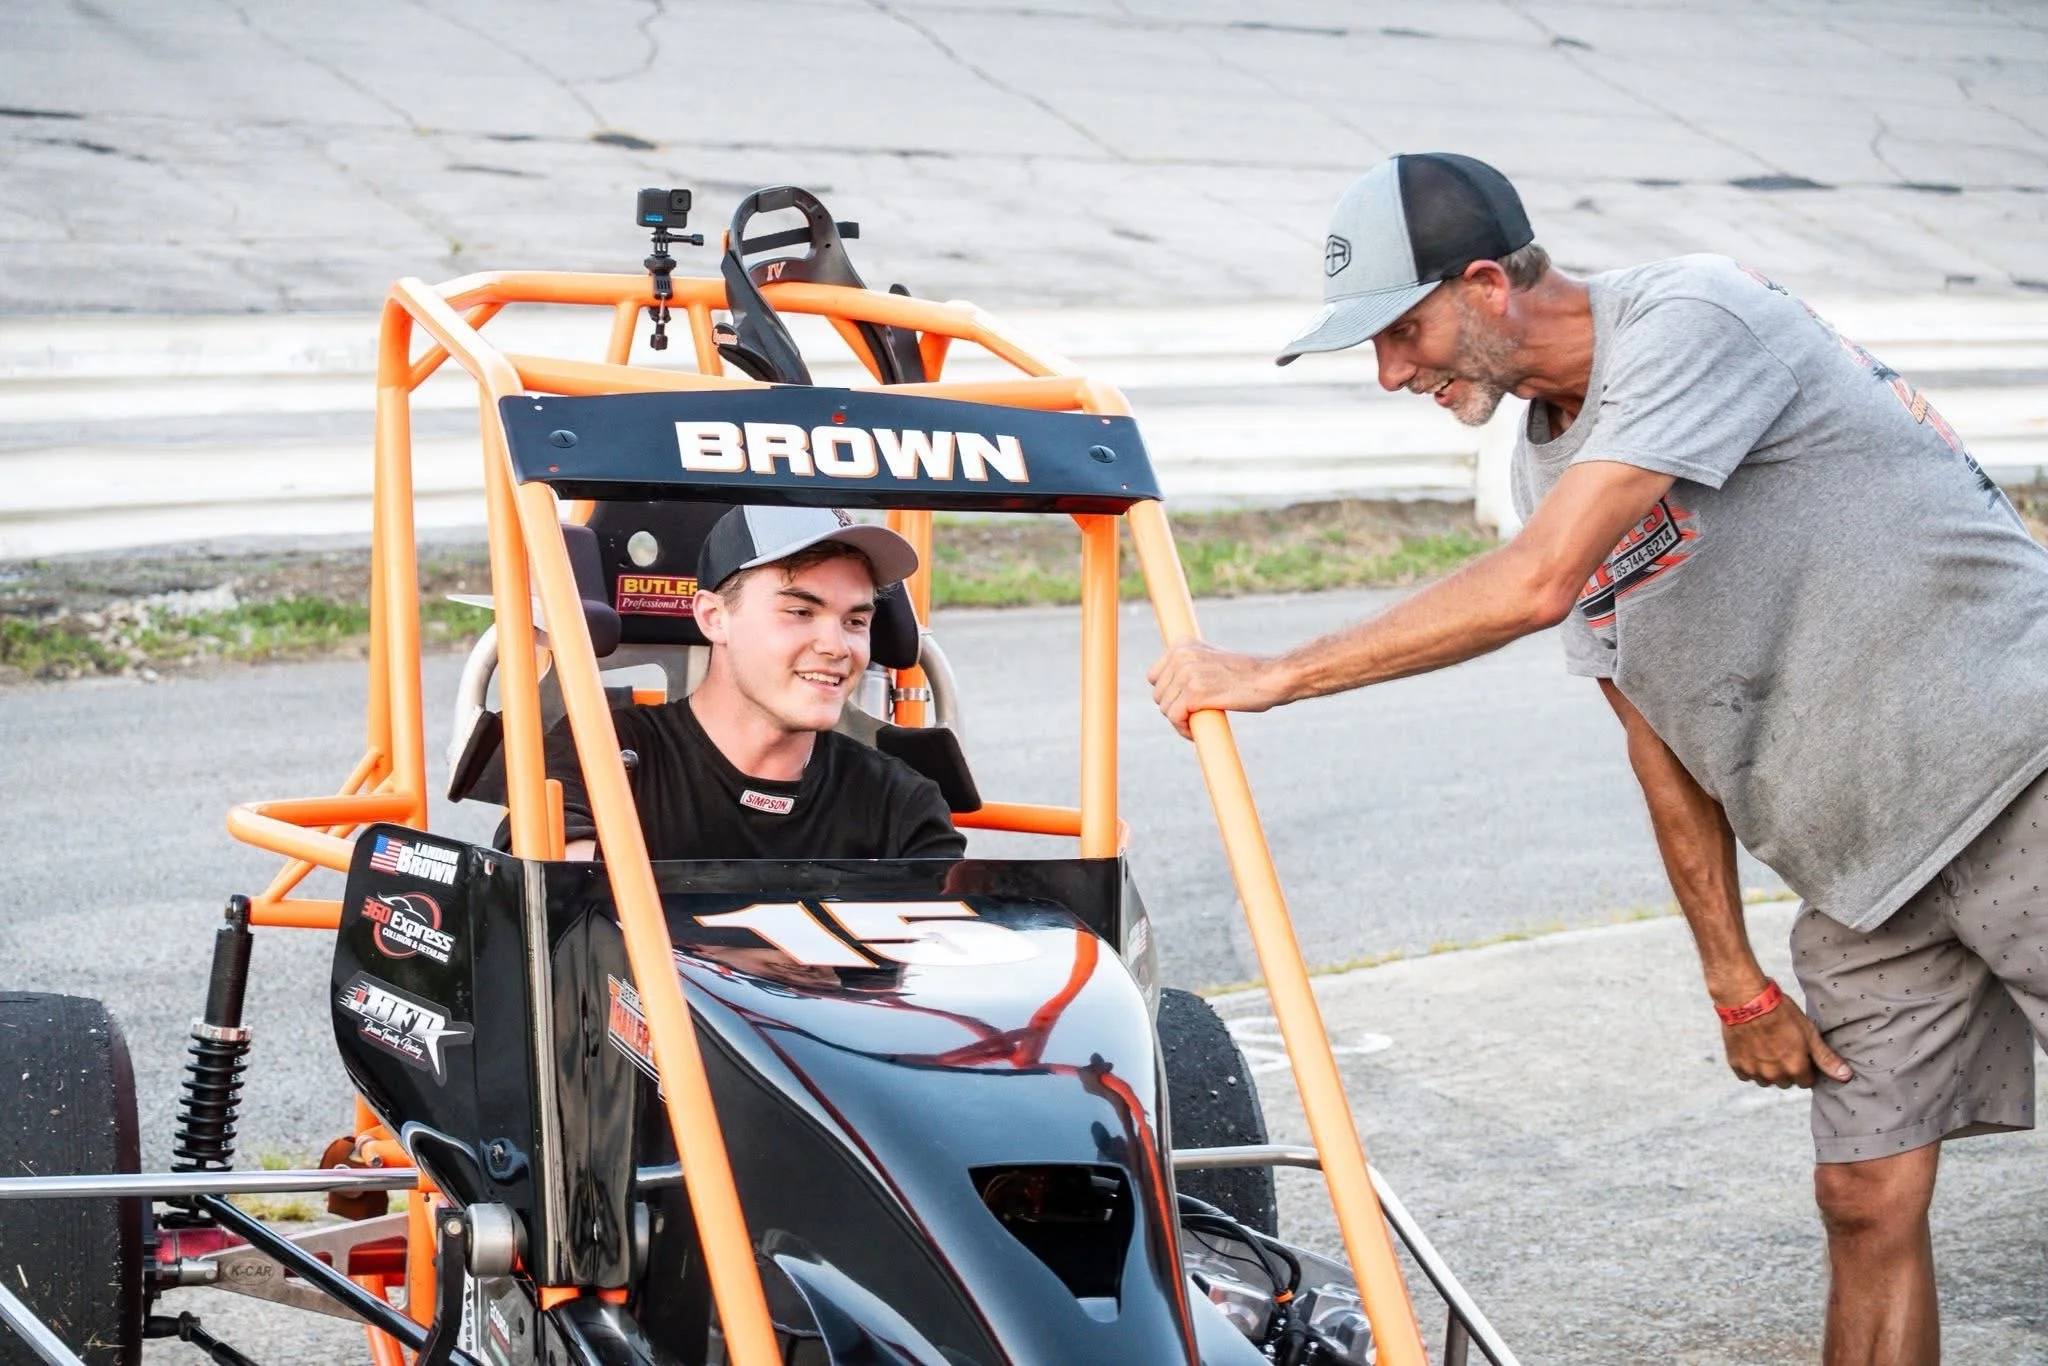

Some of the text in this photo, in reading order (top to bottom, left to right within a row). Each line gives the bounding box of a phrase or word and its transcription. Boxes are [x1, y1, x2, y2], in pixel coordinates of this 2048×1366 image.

[674, 421, 1029, 484] BROWN
[621, 597, 679, 610] Professional
[746, 794, 789, 810] SIMPSON
[395, 845, 458, 886] BROWN
[361, 897, 454, 952] 360 Express
[693, 900, 1045, 967] 15
[231, 1265, 272, 1277] K-CAR
